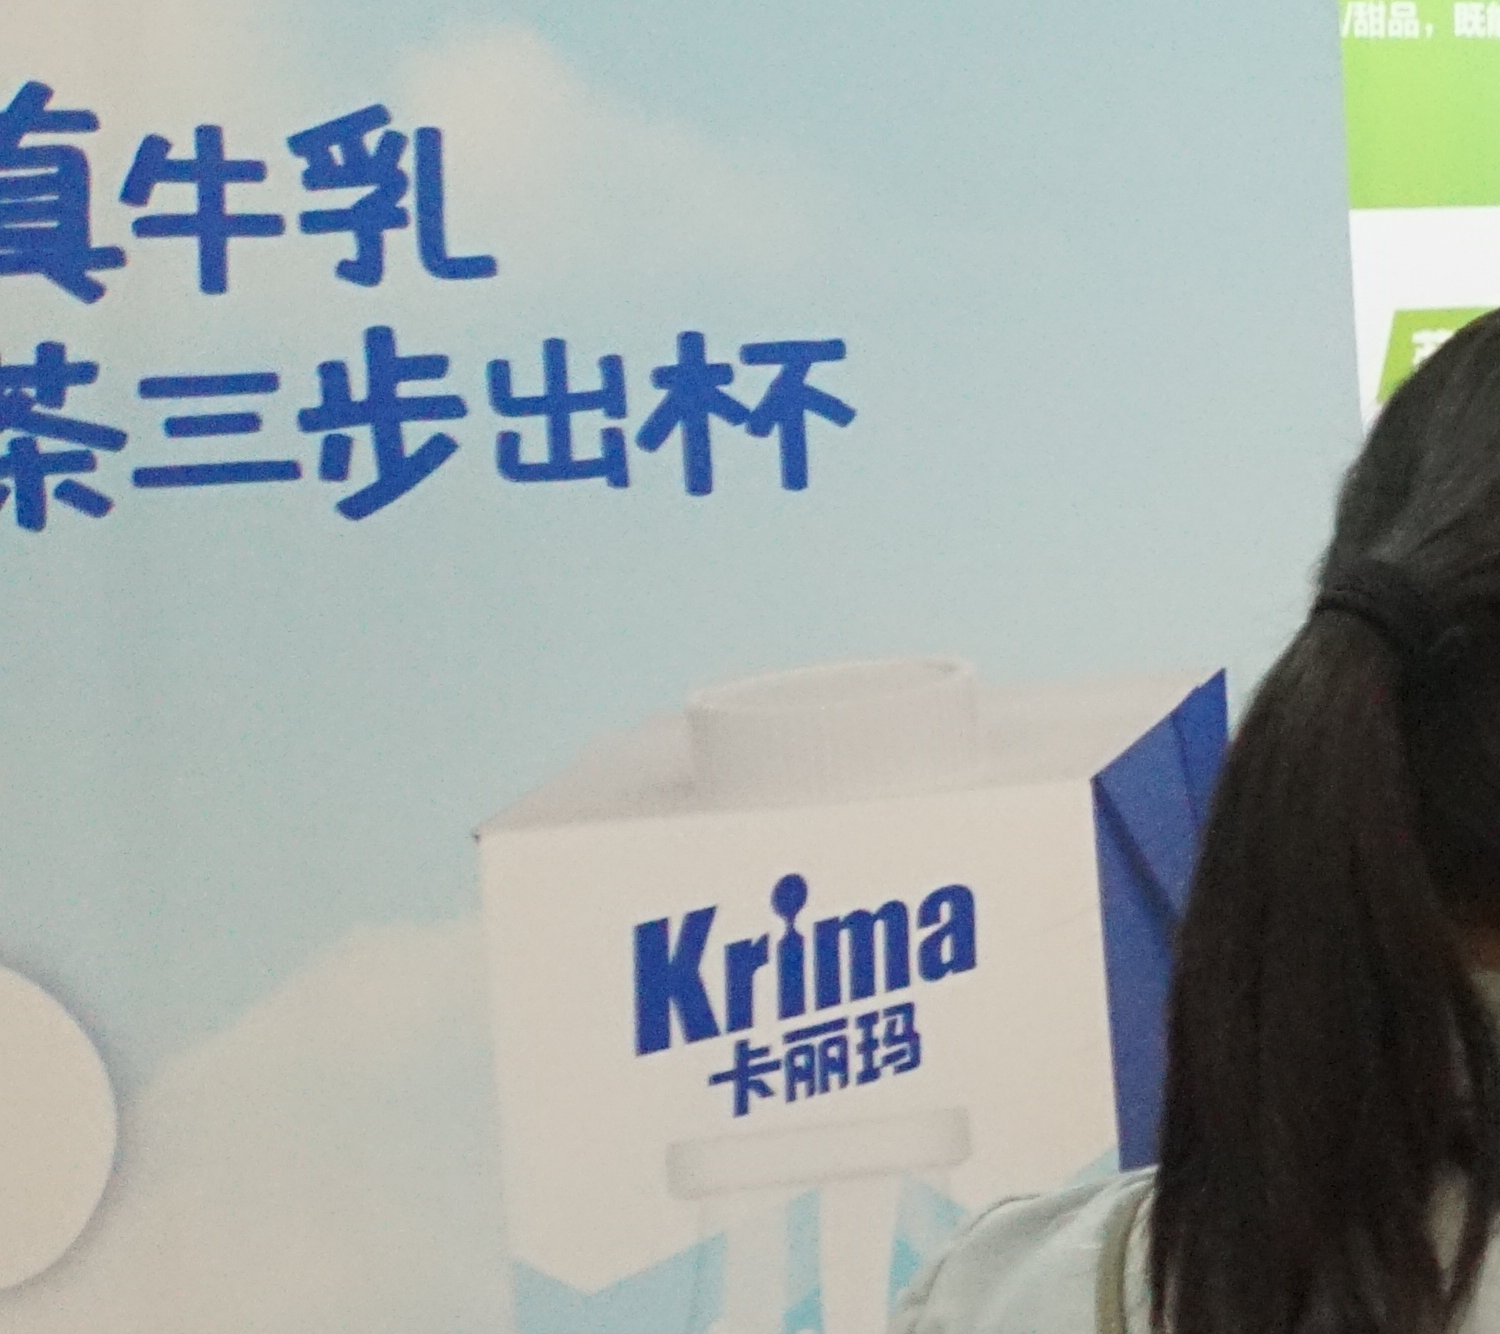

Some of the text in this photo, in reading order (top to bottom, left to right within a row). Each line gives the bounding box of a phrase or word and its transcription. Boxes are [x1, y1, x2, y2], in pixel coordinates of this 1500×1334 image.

[0, 79, 499, 305] 真牛乳
[0, 325, 857, 532] 茶三步出杯
[633, 872, 977, 1056] Krima
[708, 1000, 922, 1118] 卡丽玛
